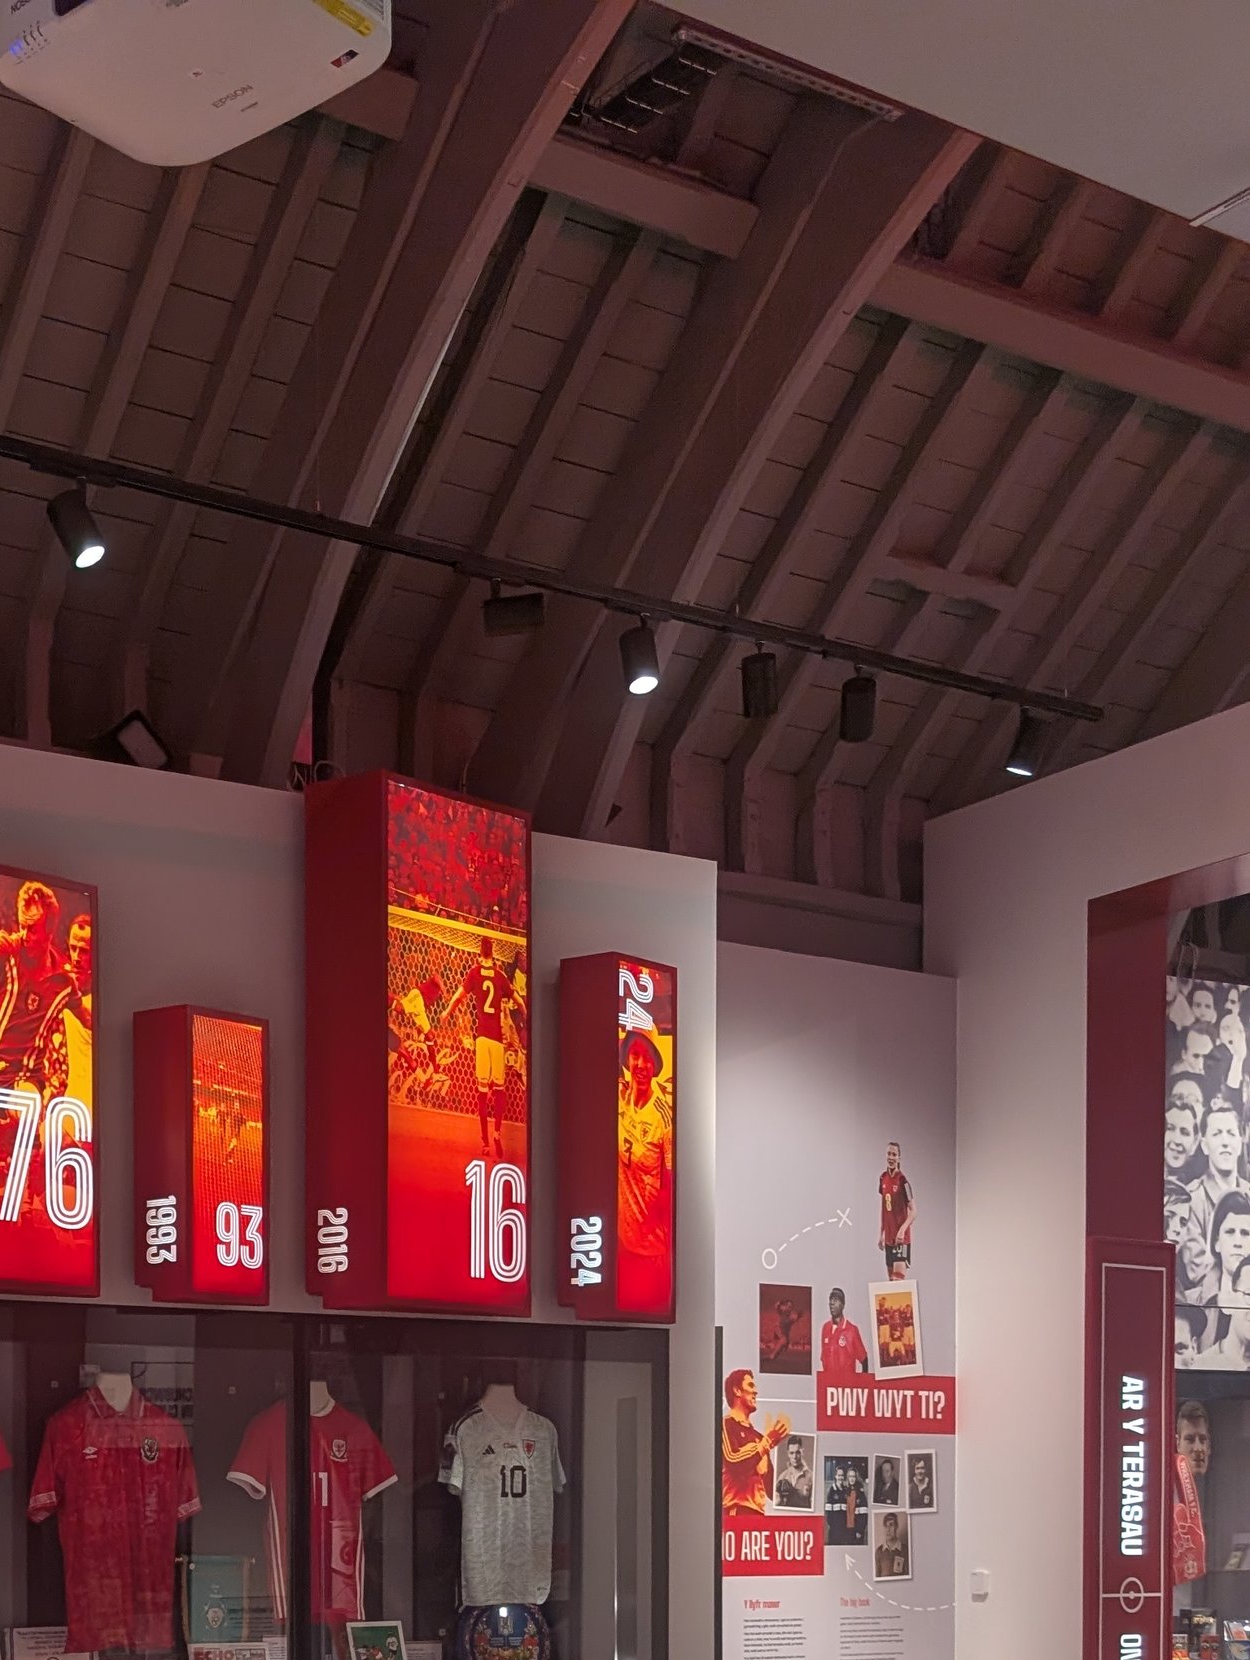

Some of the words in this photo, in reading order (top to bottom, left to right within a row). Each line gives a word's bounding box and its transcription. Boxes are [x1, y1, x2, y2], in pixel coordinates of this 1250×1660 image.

[211, 84, 254, 109] EPSON
[482, 980, 495, 1014] 2
[618, 968, 655, 1031] 24
[146, 1195, 177, 1265] 1993
[215, 1201, 263, 1270] 93
[318, 1207, 348, 1274] 2016
[465, 1159, 527, 1283] 16
[570, 1215, 603, 1287] 2024
[826, 1387, 868, 1417] PWY
[874, 1388, 916, 1419] WYT
[918, 1390, 946, 1420] TI?
[1122, 1375, 1144, 1410] AR
[1122, 1418, 1144, 1434] Y
[500, 1464, 527, 1498] 10
[1120, 1440, 1144, 1556] TERASAU
[741, 1531, 770, 1561] ARE
[774, 1531, 814, 1561] YOU?
